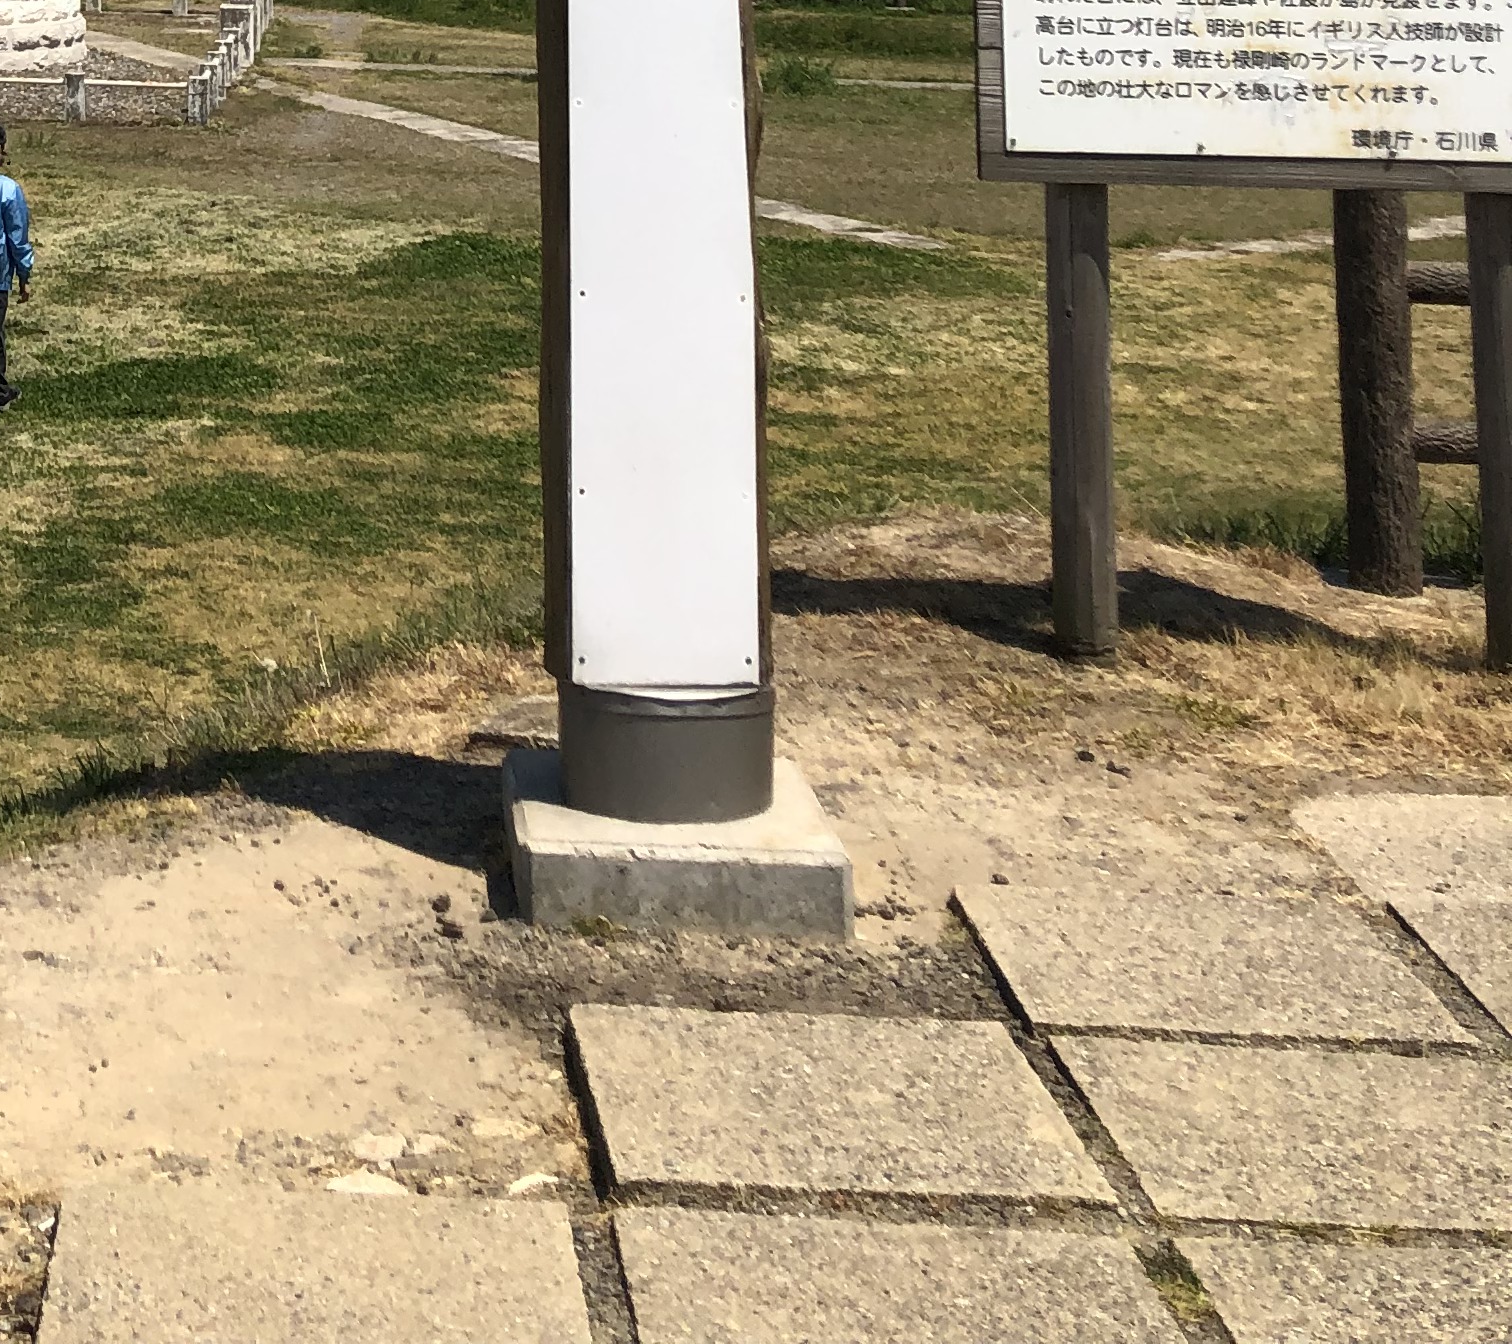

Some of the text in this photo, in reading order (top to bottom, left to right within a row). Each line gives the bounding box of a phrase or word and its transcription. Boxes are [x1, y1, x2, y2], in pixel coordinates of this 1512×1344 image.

[1351, 128, 1512, 152] 環境庁・石川県
